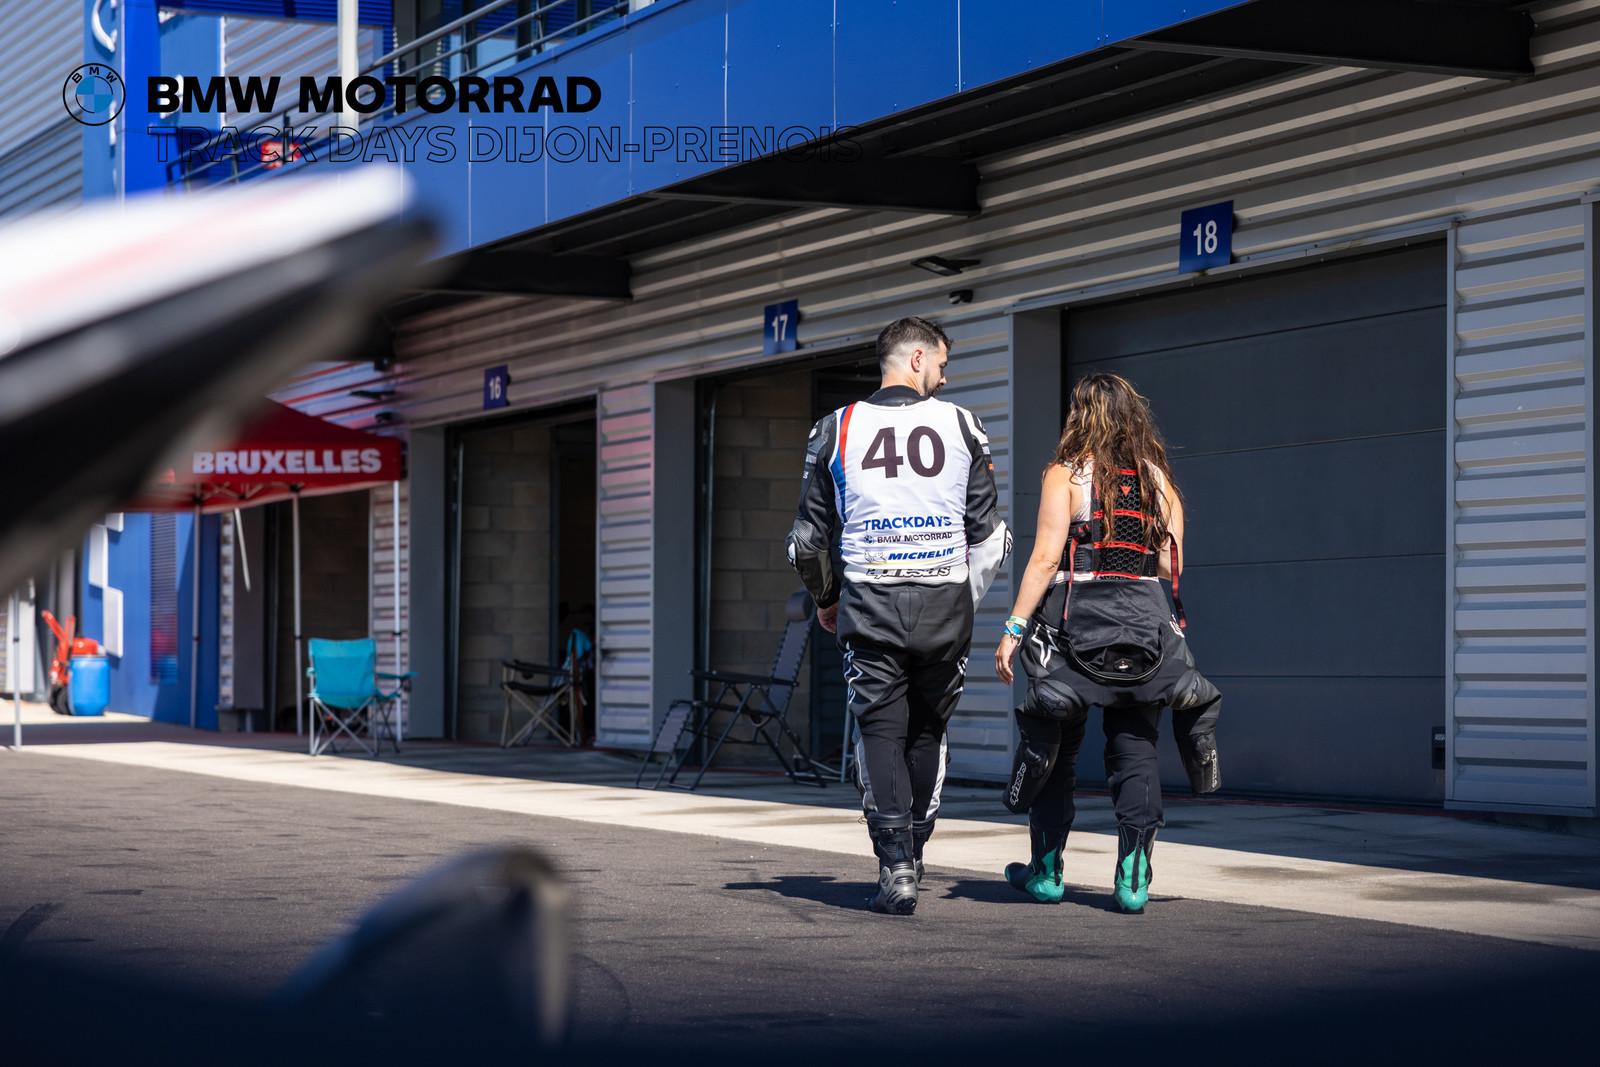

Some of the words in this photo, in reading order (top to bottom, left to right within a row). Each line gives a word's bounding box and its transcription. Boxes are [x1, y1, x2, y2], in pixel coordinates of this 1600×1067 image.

[1193, 219, 1218, 256] 18
[771, 314, 789, 343] 17
[489, 376, 502, 400] 16
[192, 448, 382, 475] BRUXELLES
[861, 425, 946, 479] 40
[863, 515, 953, 531] TRACKDAYS
[877, 535, 902, 544] BMW
[904, 531, 953, 542] MOTORRAD
[887, 546, 955, 561] MICHELIN
